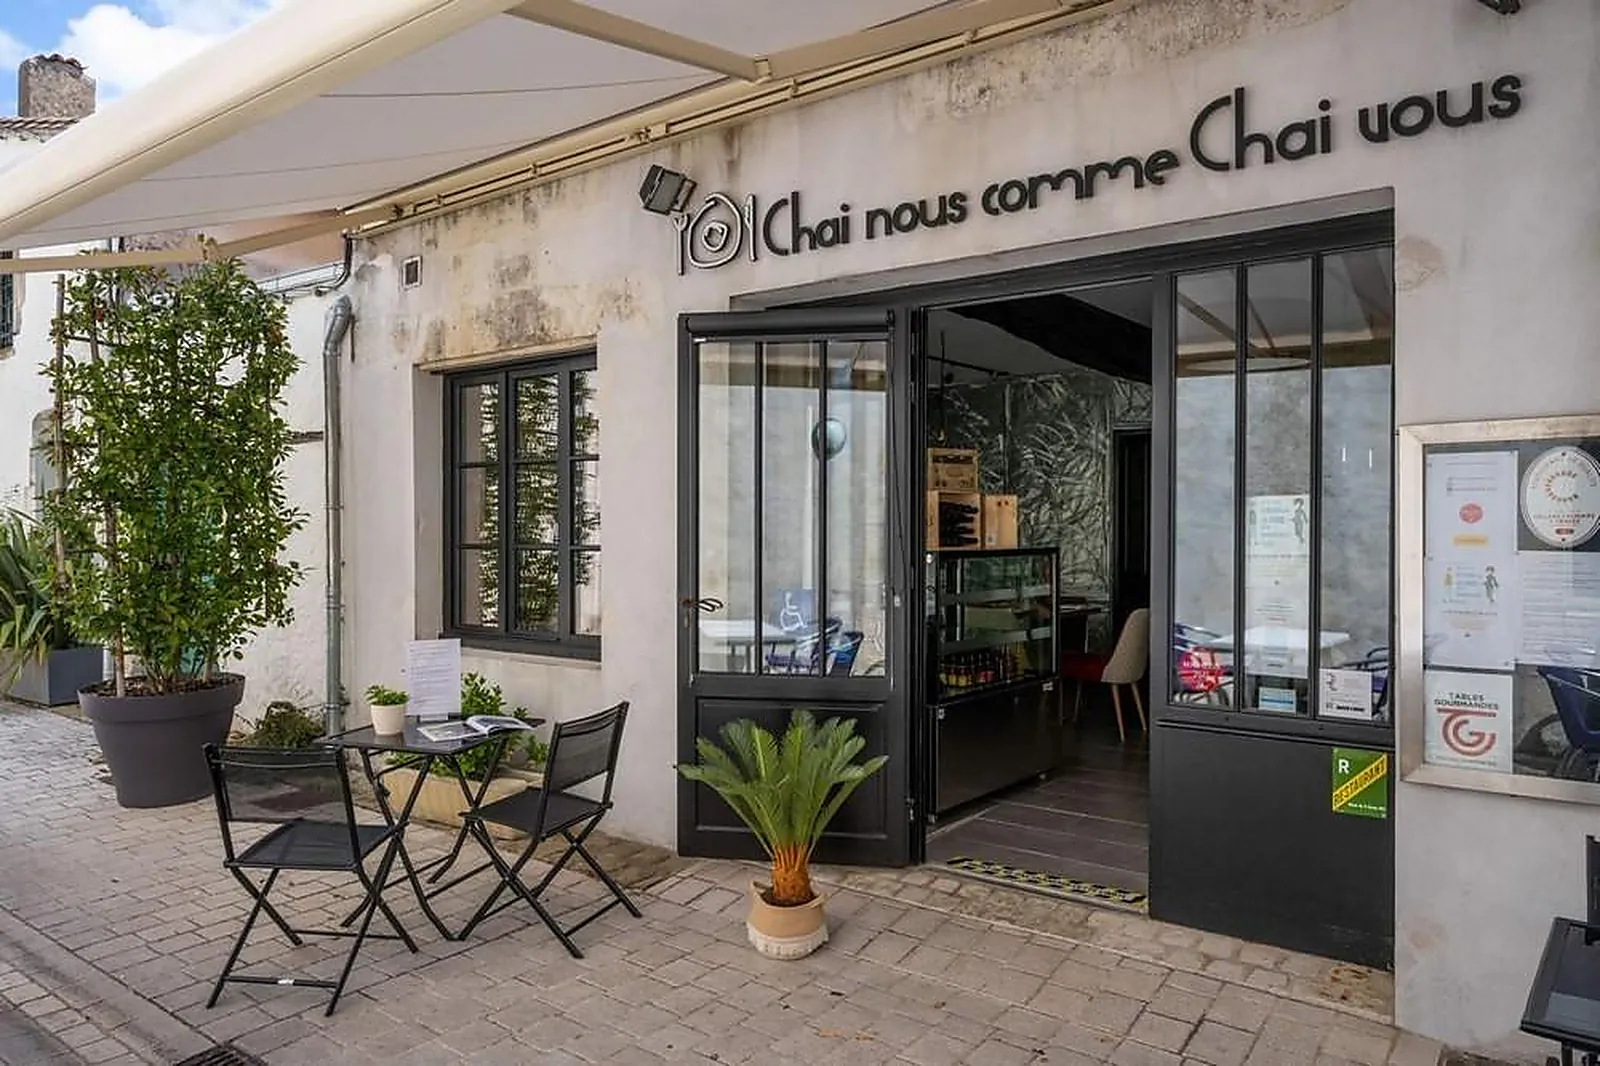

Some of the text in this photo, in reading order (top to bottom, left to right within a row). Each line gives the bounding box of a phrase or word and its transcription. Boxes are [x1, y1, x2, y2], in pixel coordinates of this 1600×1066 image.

[762, 74, 1523, 256] Chai nous comme Chai vous
[1338, 758, 1350, 774] R
